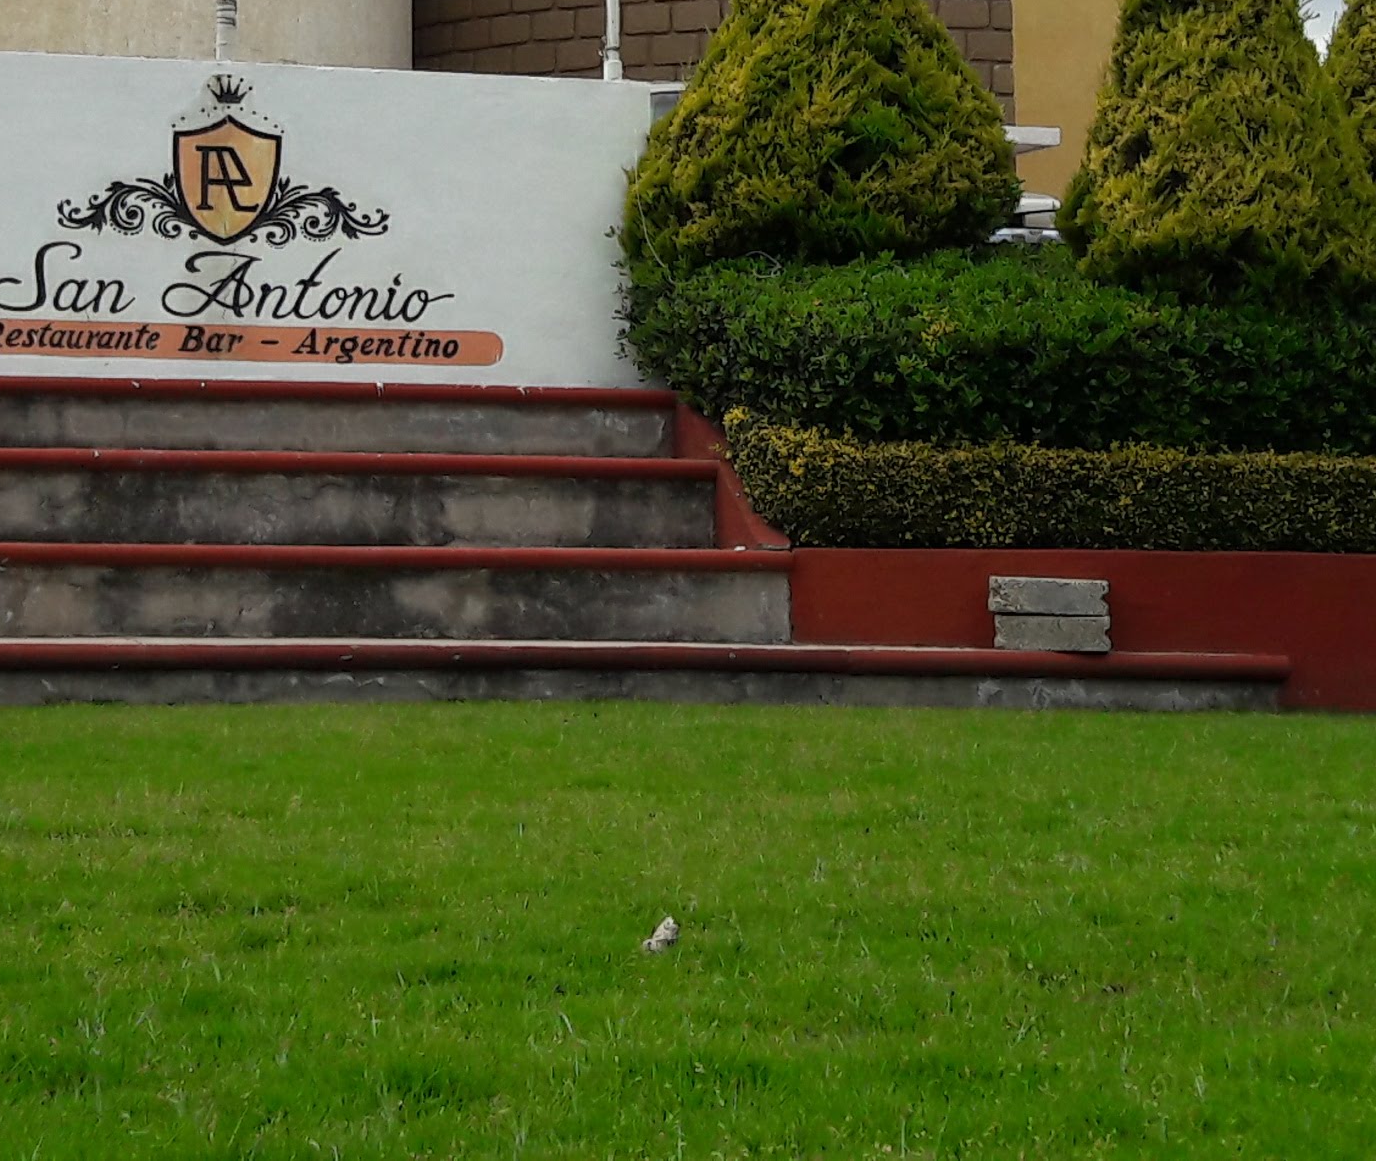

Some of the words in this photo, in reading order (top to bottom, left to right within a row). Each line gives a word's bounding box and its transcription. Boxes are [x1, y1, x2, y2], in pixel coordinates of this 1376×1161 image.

[162, 247, 455, 322] Antonio
[178, 325, 244, 353] Bar
[291, 328, 460, 364] Argentino
